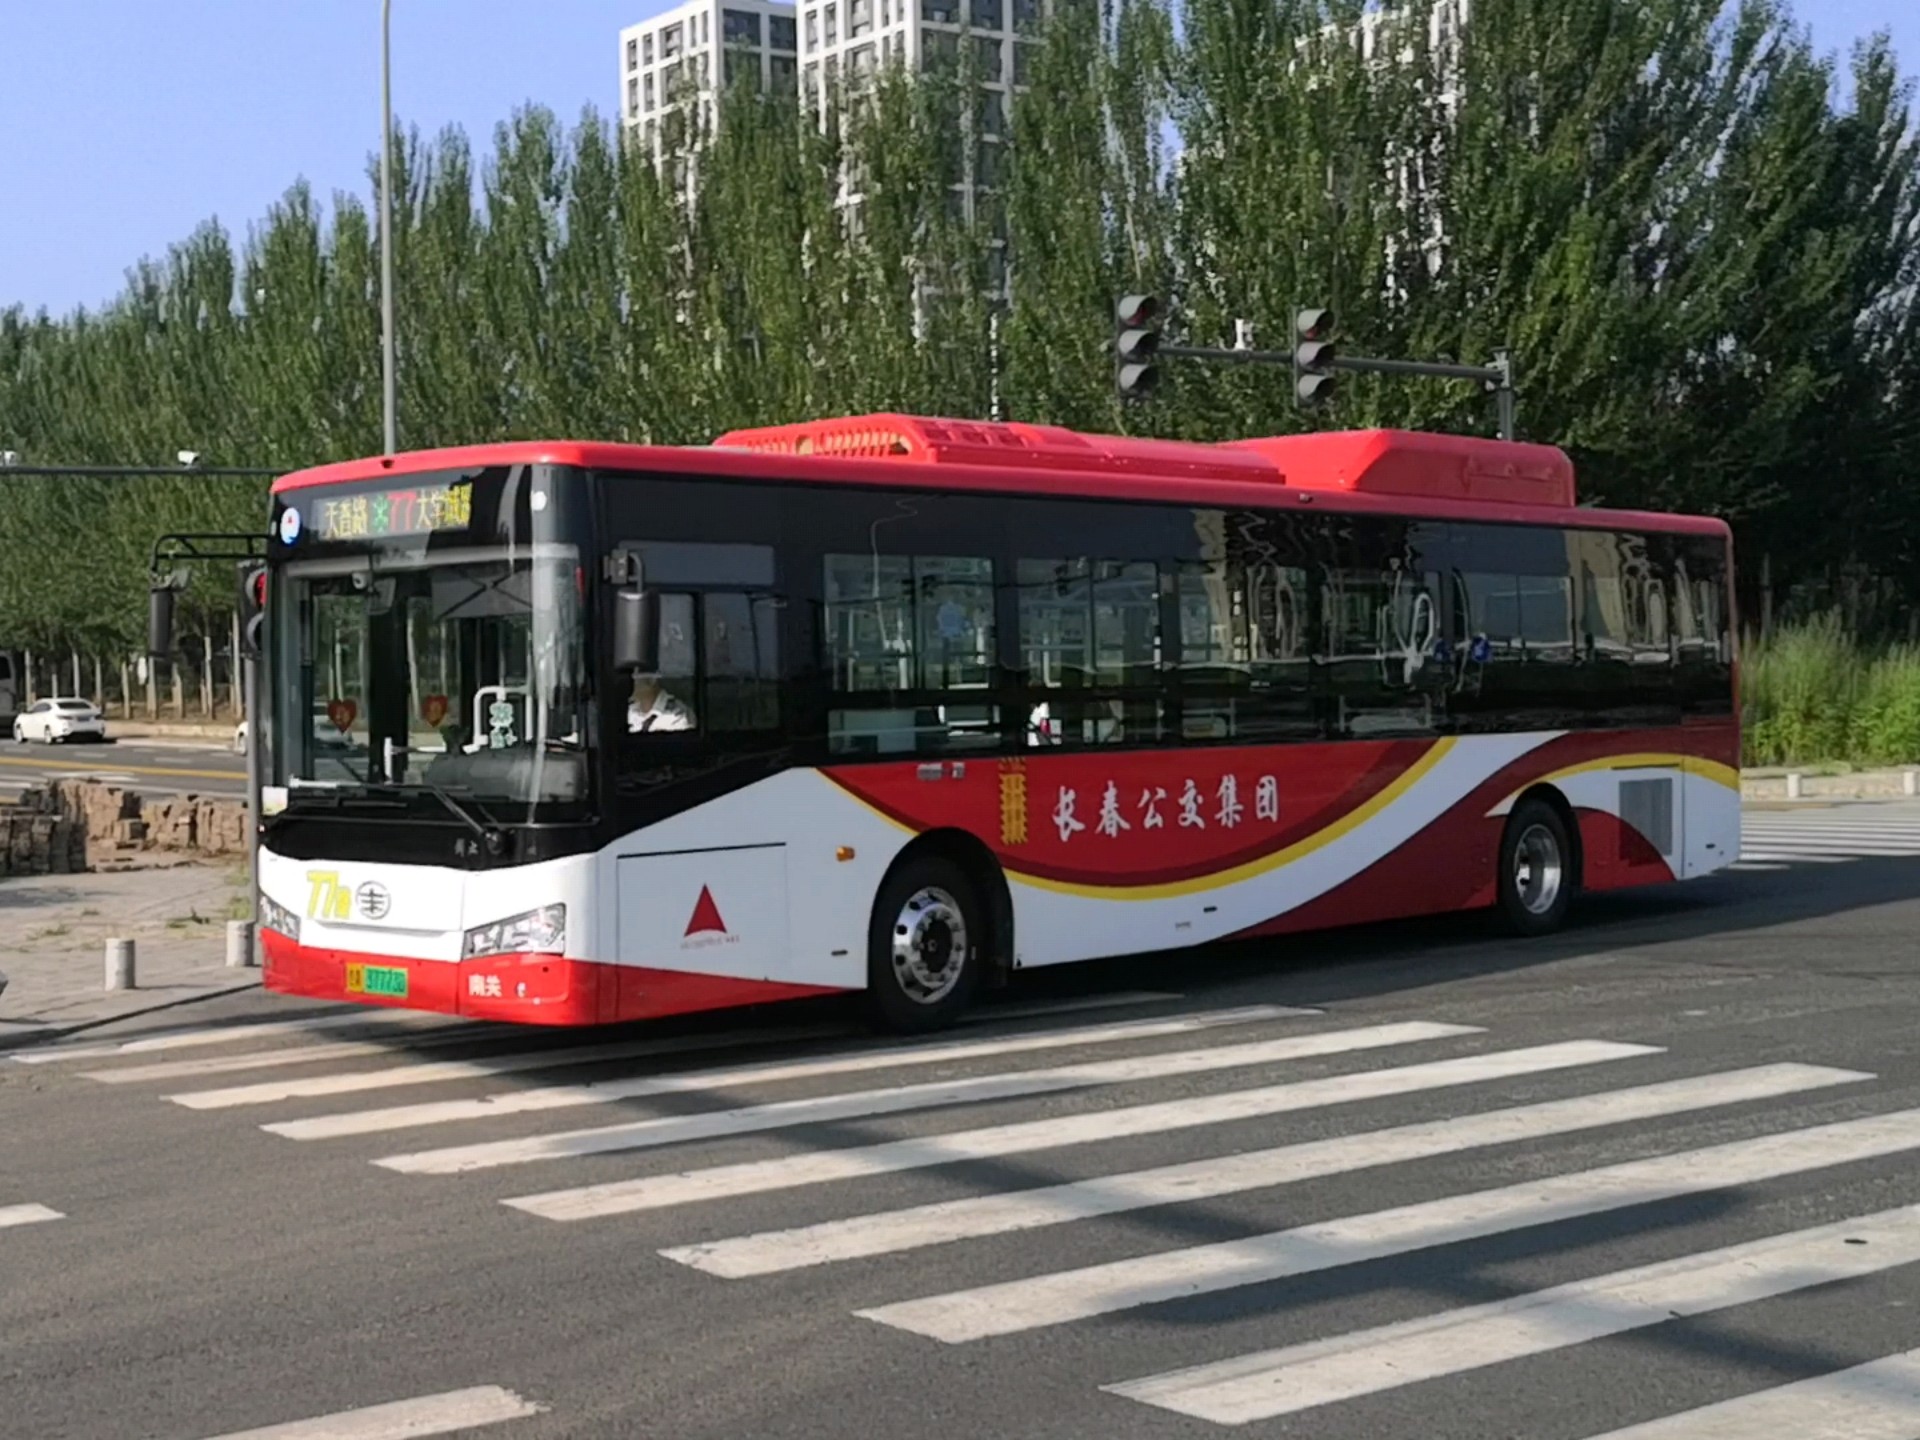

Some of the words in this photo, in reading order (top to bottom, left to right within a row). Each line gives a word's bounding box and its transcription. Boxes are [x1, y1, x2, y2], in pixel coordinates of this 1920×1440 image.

[388, 490, 416, 532] 77
[1052, 774, 1279, 842] 长春公交集团
